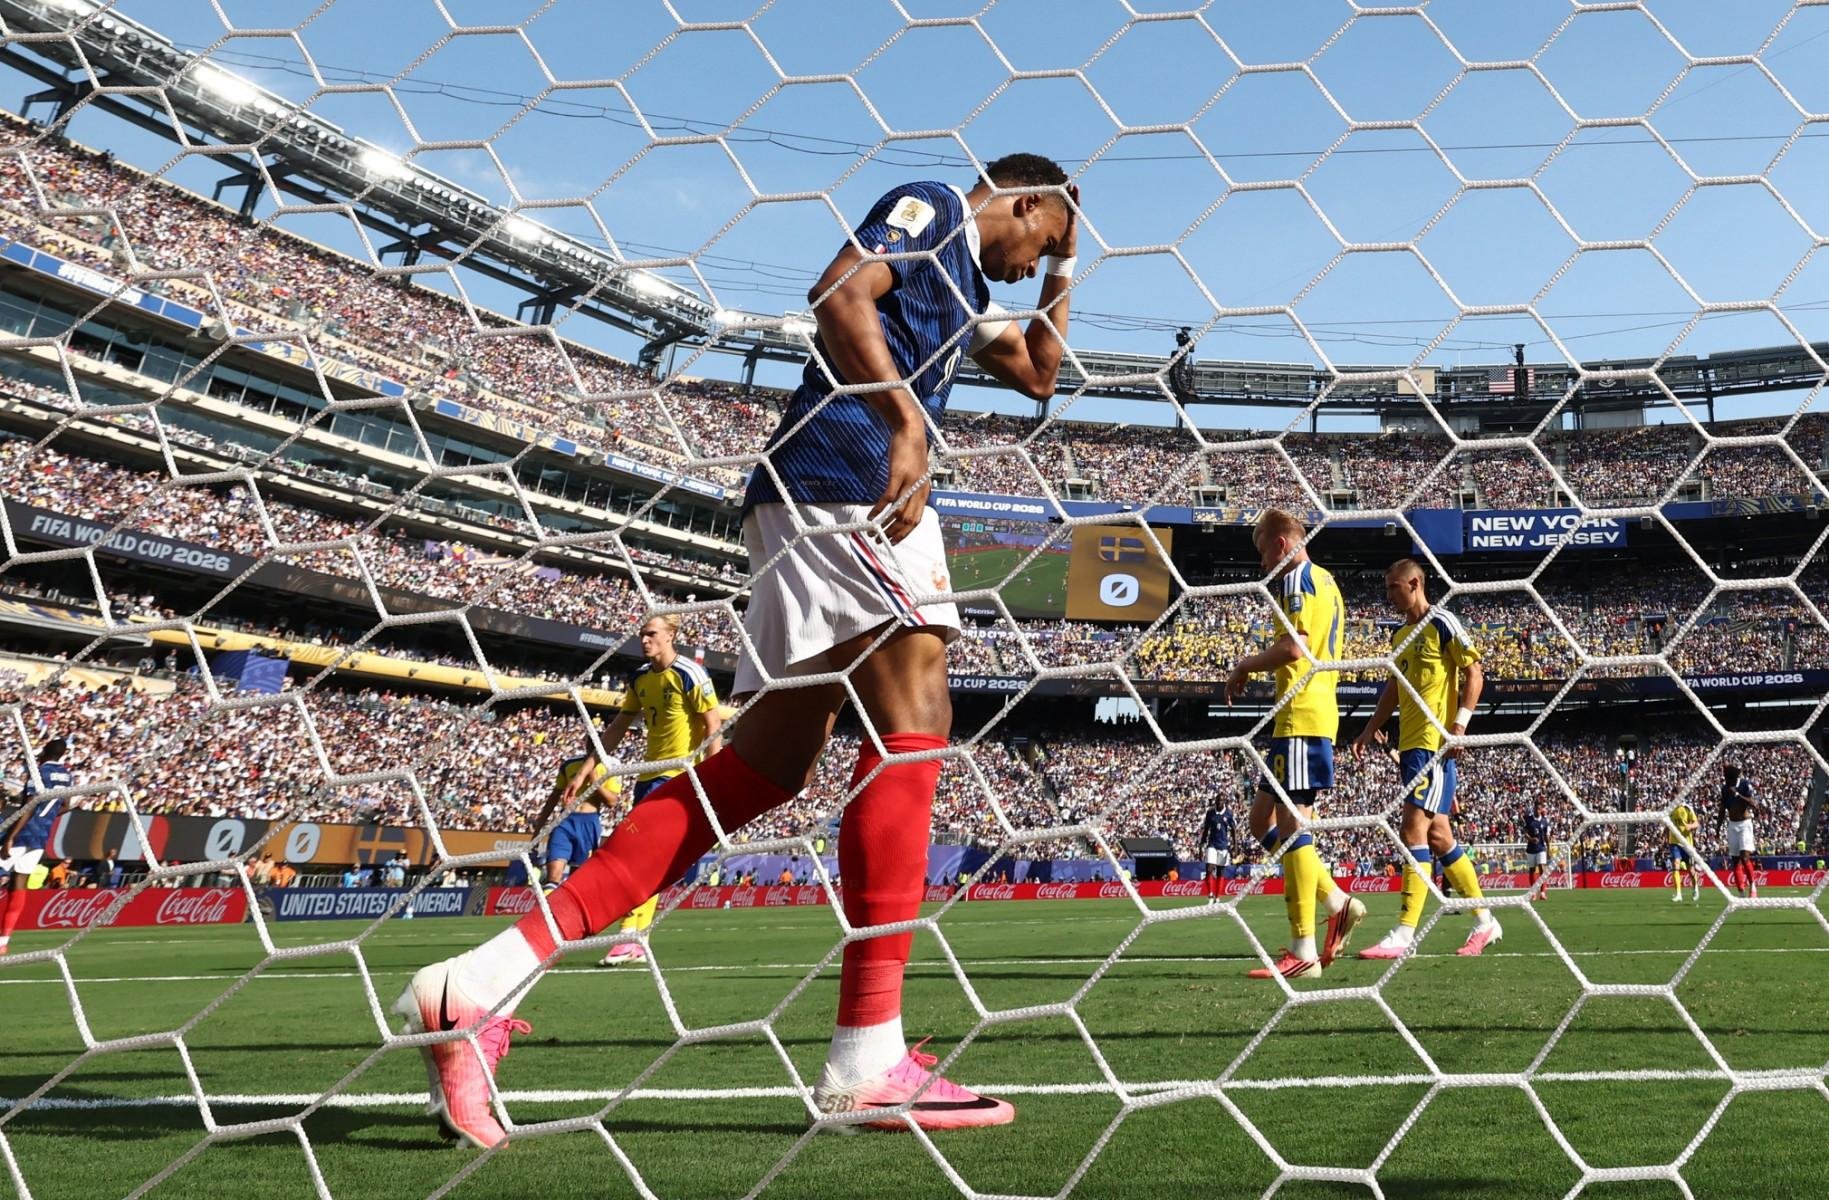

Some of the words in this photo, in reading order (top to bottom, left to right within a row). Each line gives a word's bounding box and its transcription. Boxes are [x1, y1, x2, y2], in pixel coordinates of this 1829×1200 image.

[936, 497, 957, 507] FIFA
[958, 499, 992, 510] WORLD
[992, 502, 1011, 511] CUP
[1012, 503, 1045, 514] 2026
[1472, 517, 1535, 531] NEW
[31, 515, 71, 538] FIFA
[138, 540, 171, 559] CUP
[172, 547, 230, 571] 2026
[1472, 535, 1524, 547] NEW
[1100, 573, 1139, 607] 0
[964, 607, 996, 615] Hisense
[963, 678, 987, 689] CUP
[988, 679, 1028, 690] 2026
[1700, 677, 1740, 688] WORLD
[1741, 676, 1763, 686] CUP
[1764, 674, 1804, 685] 2026
[1414, 775, 1429, 800] 2
[284, 822, 321, 864] 0
[1162, 880, 1202, 896] Coca-Cola
[1350, 876, 1391, 892] Coca-Cola
[1601, 872, 1641, 888] Coca-Cola
[692, 886, 722, 908] Coca-Cola
[731, 886, 756, 907] Coca-Cola
[973, 883, 1017, 900] Coca-Cola
[1036, 883, 1077, 899] Coca-Cola
[156, 889, 234, 924] Coca-Cola
[280, 893, 336, 916] UNITED
[336, 893, 389, 915] STATES
